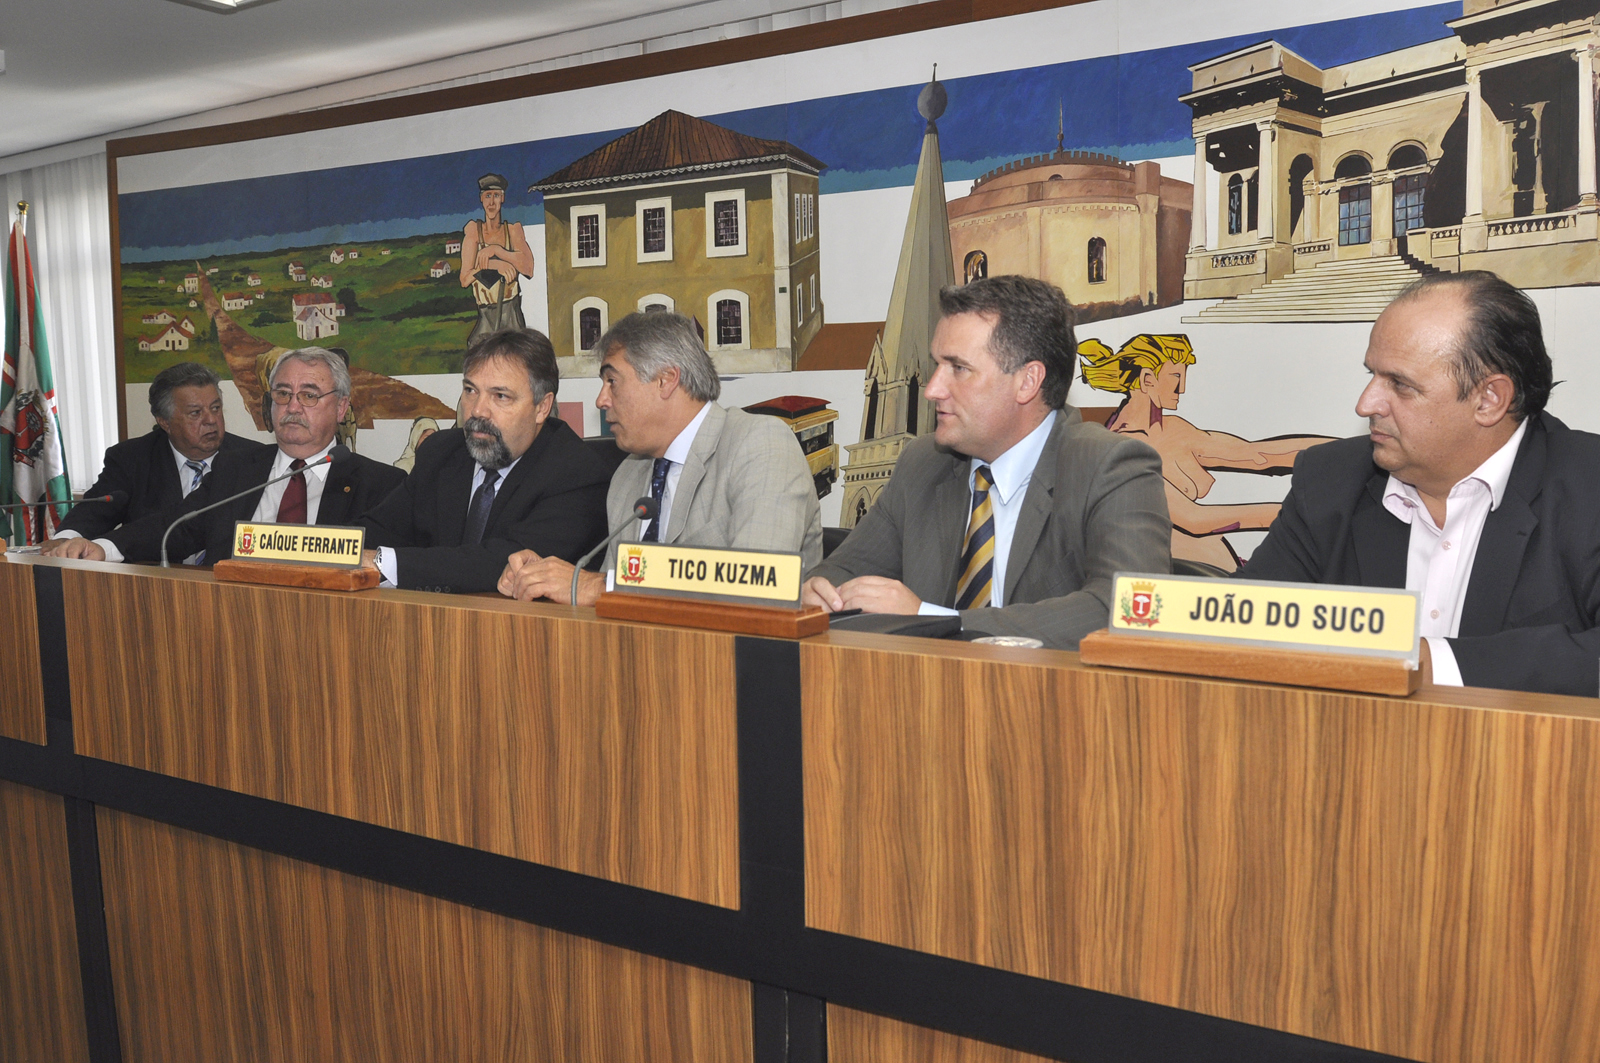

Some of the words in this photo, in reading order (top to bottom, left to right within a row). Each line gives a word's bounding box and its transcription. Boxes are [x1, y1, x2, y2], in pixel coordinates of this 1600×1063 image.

[259, 530, 298, 552] CAÍQUE
[301, 536, 359, 555] FERRANTE
[668, 558, 707, 581] TICO
[714, 561, 777, 587] KUZMA
[1189, 594, 1253, 624] JOÃO
[1266, 601, 1300, 628] DO
[1313, 605, 1385, 634] SUCO
